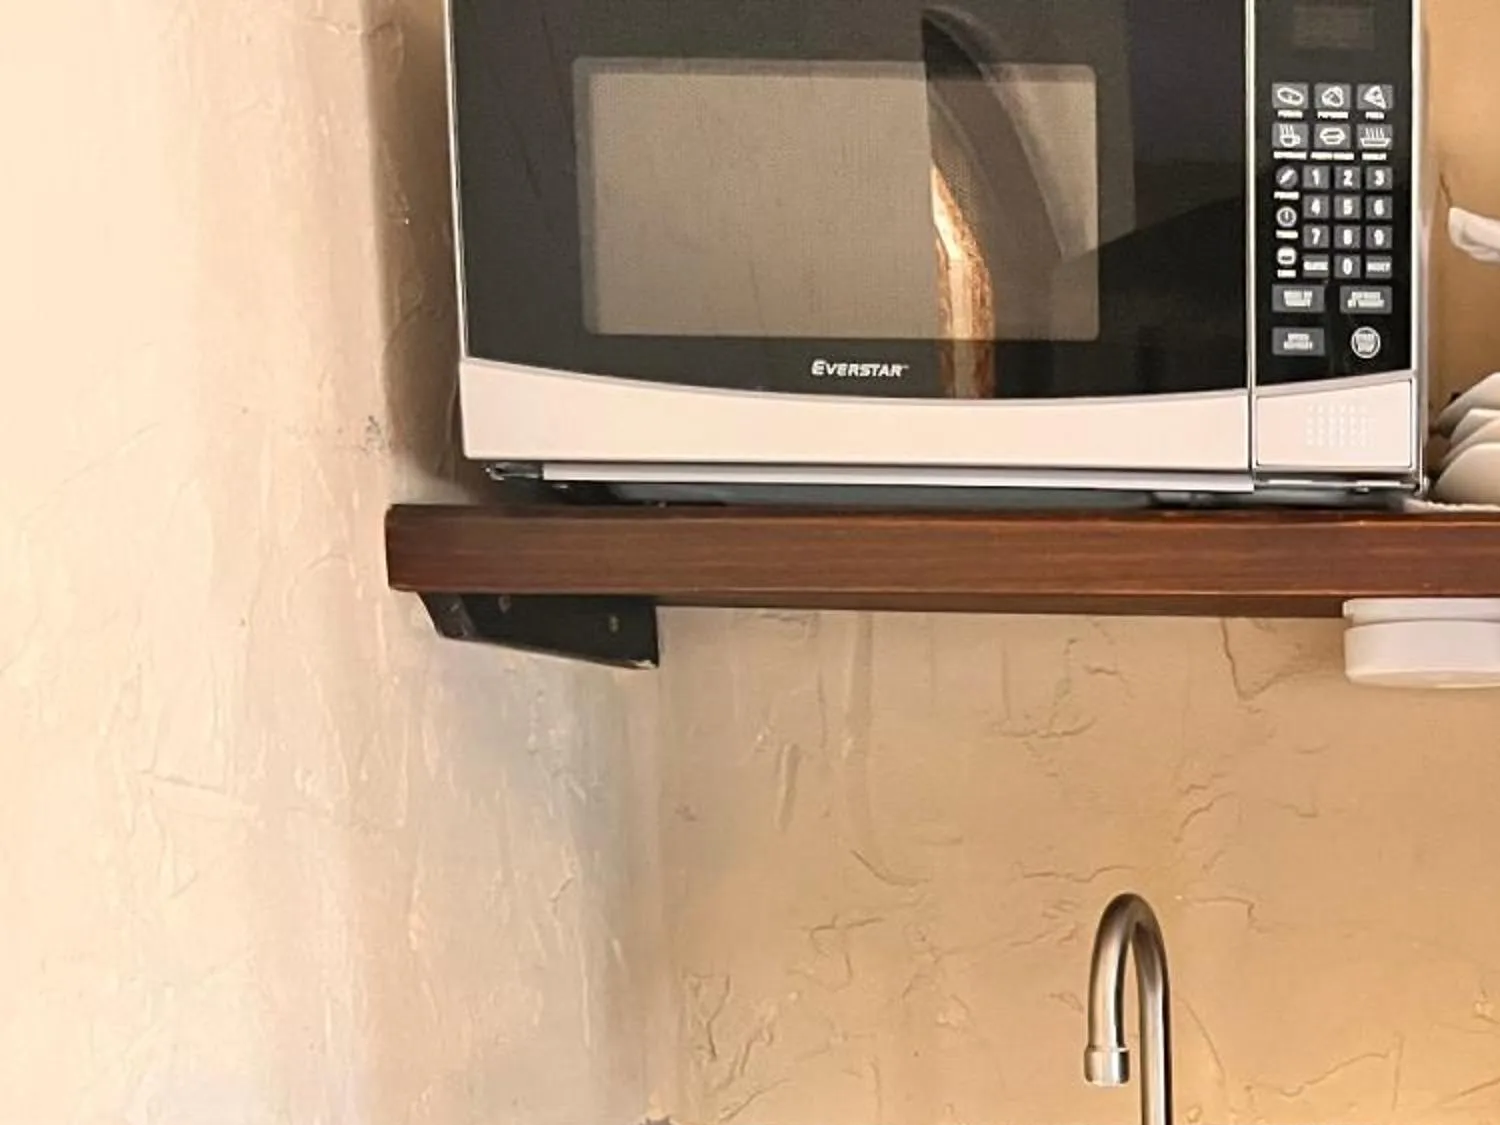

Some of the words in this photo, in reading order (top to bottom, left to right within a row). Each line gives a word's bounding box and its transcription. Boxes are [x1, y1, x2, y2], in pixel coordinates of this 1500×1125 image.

[1312, 168, 1319, 186] 1
[1343, 168, 1353, 187] 2
[1374, 168, 1385, 187] 3
[1311, 198, 1320, 215] 4
[1343, 198, 1353, 216] 5
[1311, 227, 1320, 245] 7
[1342, 257, 1353, 275] 0
[811, 359, 904, 377] EVERSTAR
